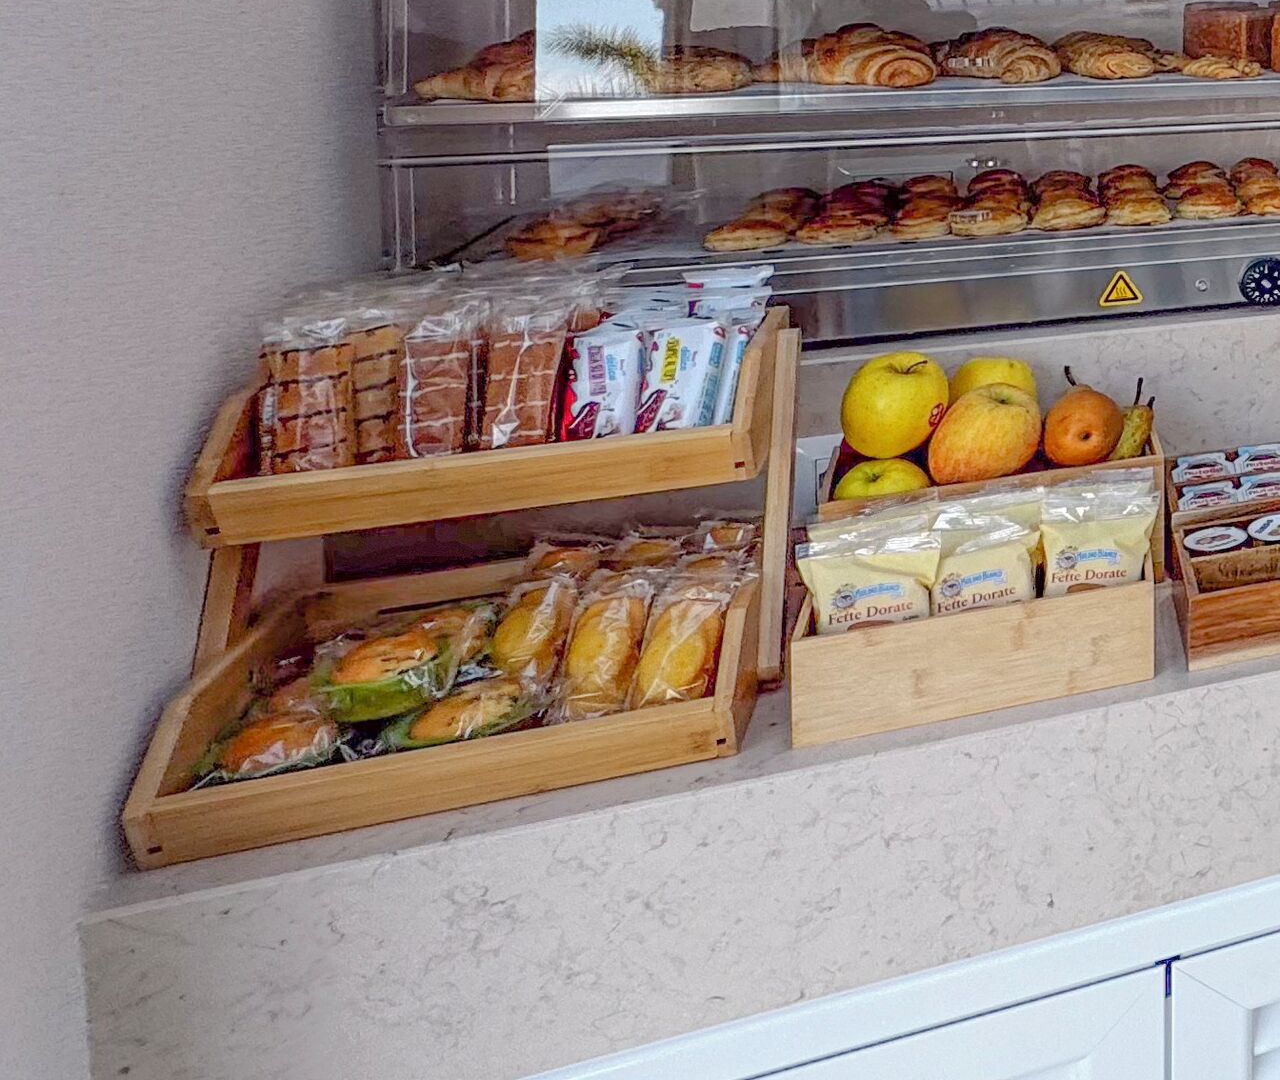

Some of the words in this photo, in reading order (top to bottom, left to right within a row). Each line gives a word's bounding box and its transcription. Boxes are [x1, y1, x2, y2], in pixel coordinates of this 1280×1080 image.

[1051, 570, 1081, 583] Fette
[1085, 568, 1127, 581] Dorate
[937, 599, 968, 613] Fette
[972, 586, 1016, 604] Dorate
[828, 610, 862, 626] Fette
[866, 601, 913, 618] Dorate
